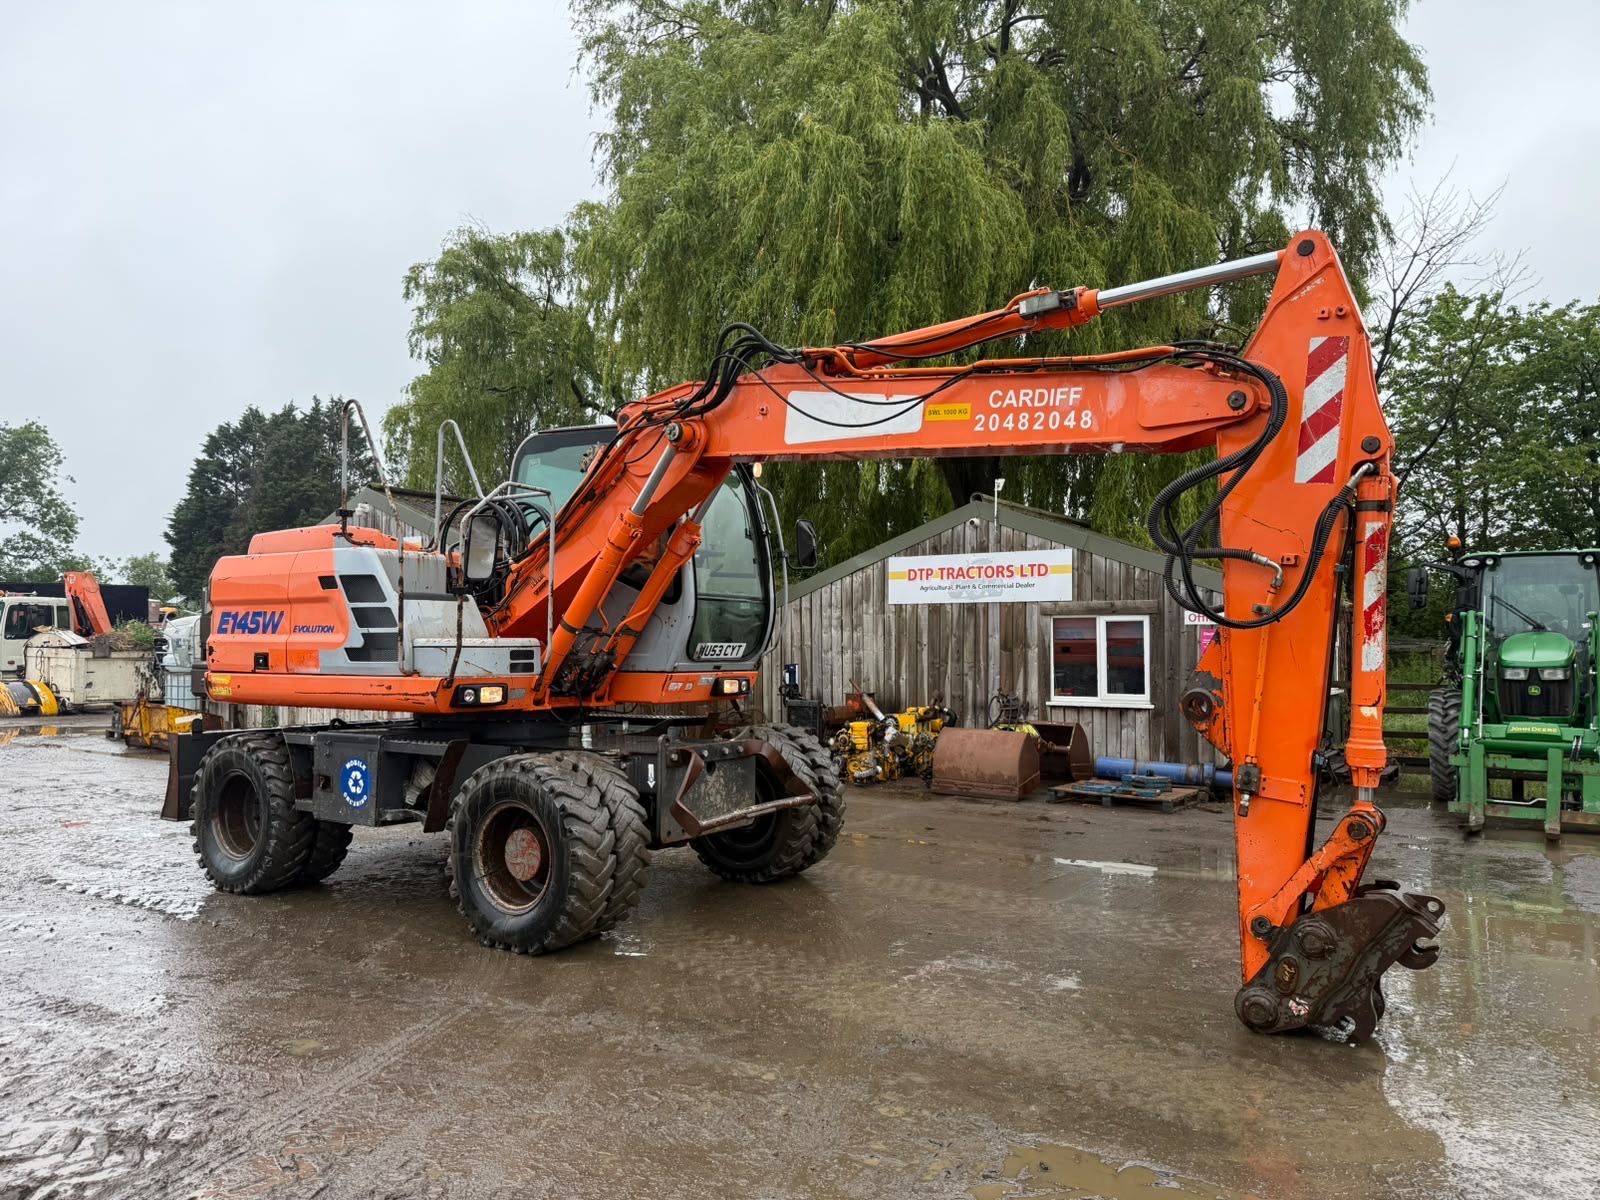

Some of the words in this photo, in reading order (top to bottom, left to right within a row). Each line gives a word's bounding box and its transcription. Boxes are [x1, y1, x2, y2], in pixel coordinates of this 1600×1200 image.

[989, 387, 1083, 409] CARDIFF
[958, 407, 968, 415] KG
[974, 409, 1093, 431] 20482048
[907, 568, 934, 581] DTP
[938, 565, 1015, 580] TRACTORS
[1020, 563, 1049, 578] LTD
[920, 584, 954, 592] Agricultural,
[978, 582, 1014, 590] Commercial
[1015, 581, 1036, 589] Dealer
[217, 611, 285, 635] E145W
[293, 624, 335, 634] EVOLUTION
[723, 645, 743, 656] CYT
